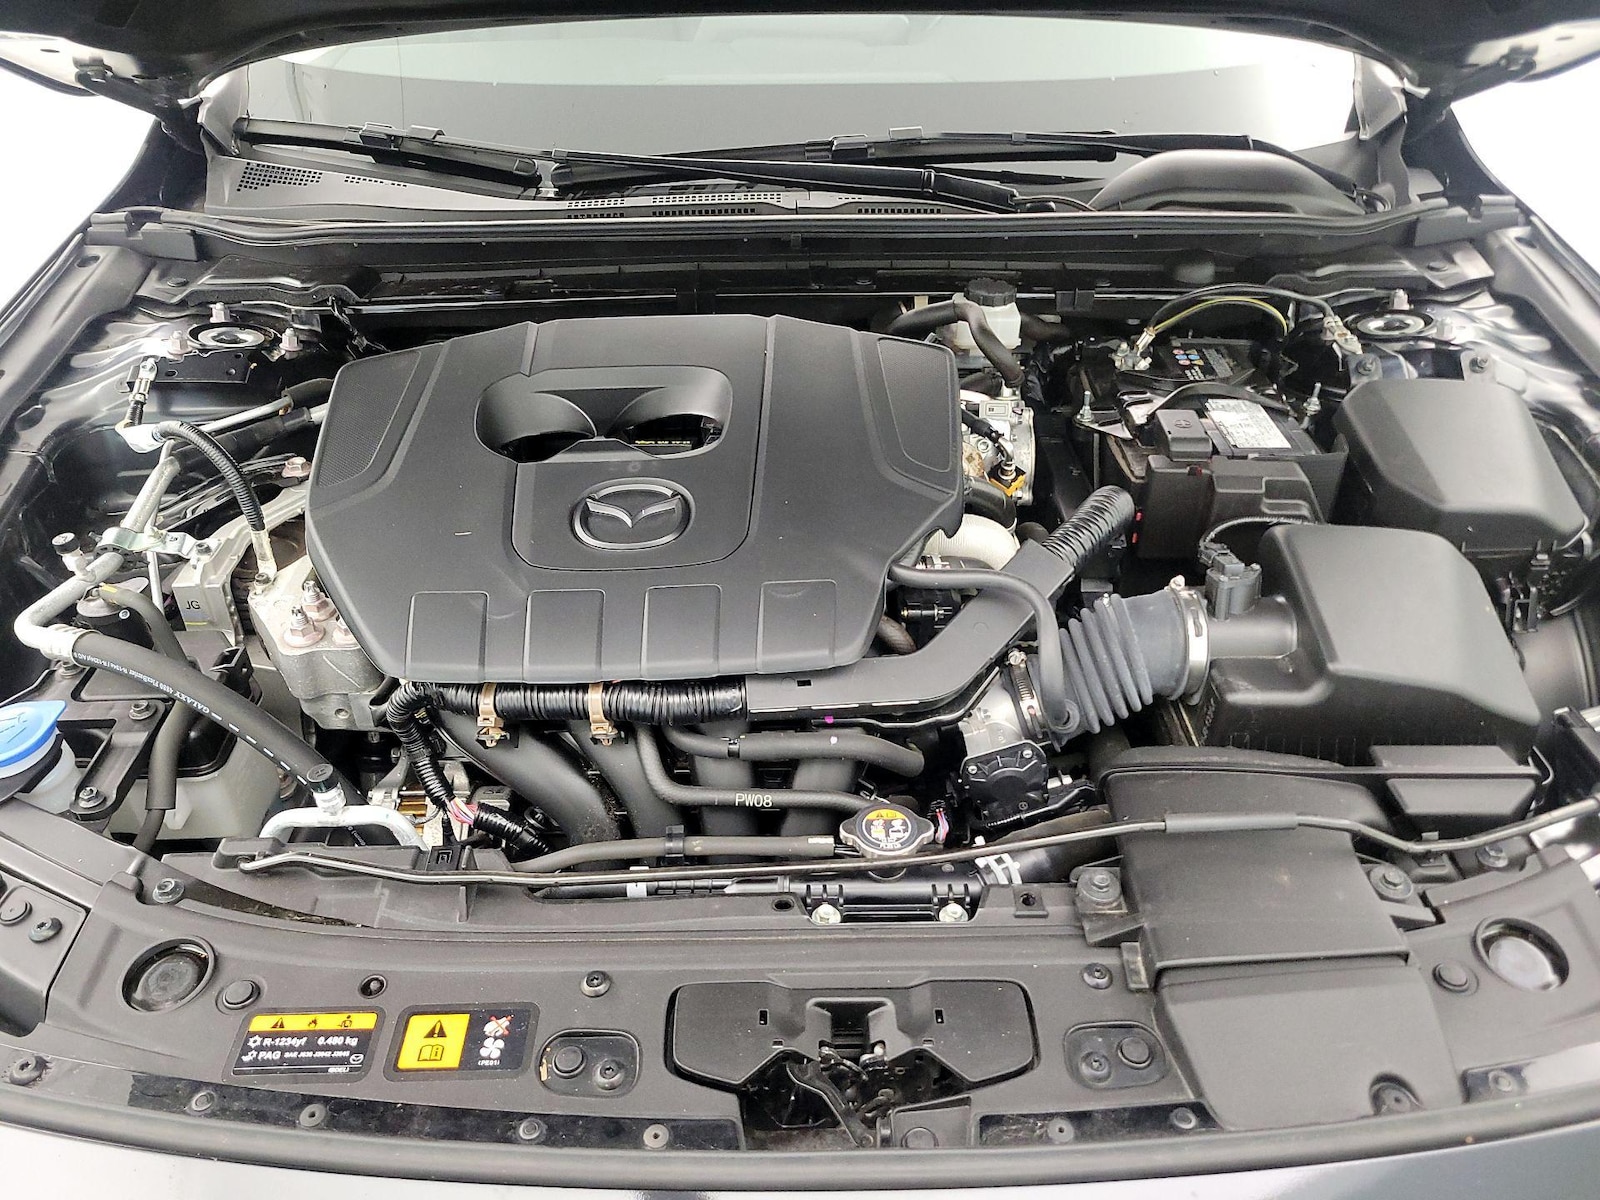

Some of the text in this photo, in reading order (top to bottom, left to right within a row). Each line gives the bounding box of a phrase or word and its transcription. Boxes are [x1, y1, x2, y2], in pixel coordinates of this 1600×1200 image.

[174, 689, 210, 714] GALAXY
[735, 792, 773, 808] PW08
[261, 1036, 307, 1047] R-1234yf
[344, 1036, 359, 1047] kg
[257, 1051, 281, 1061] PAG
